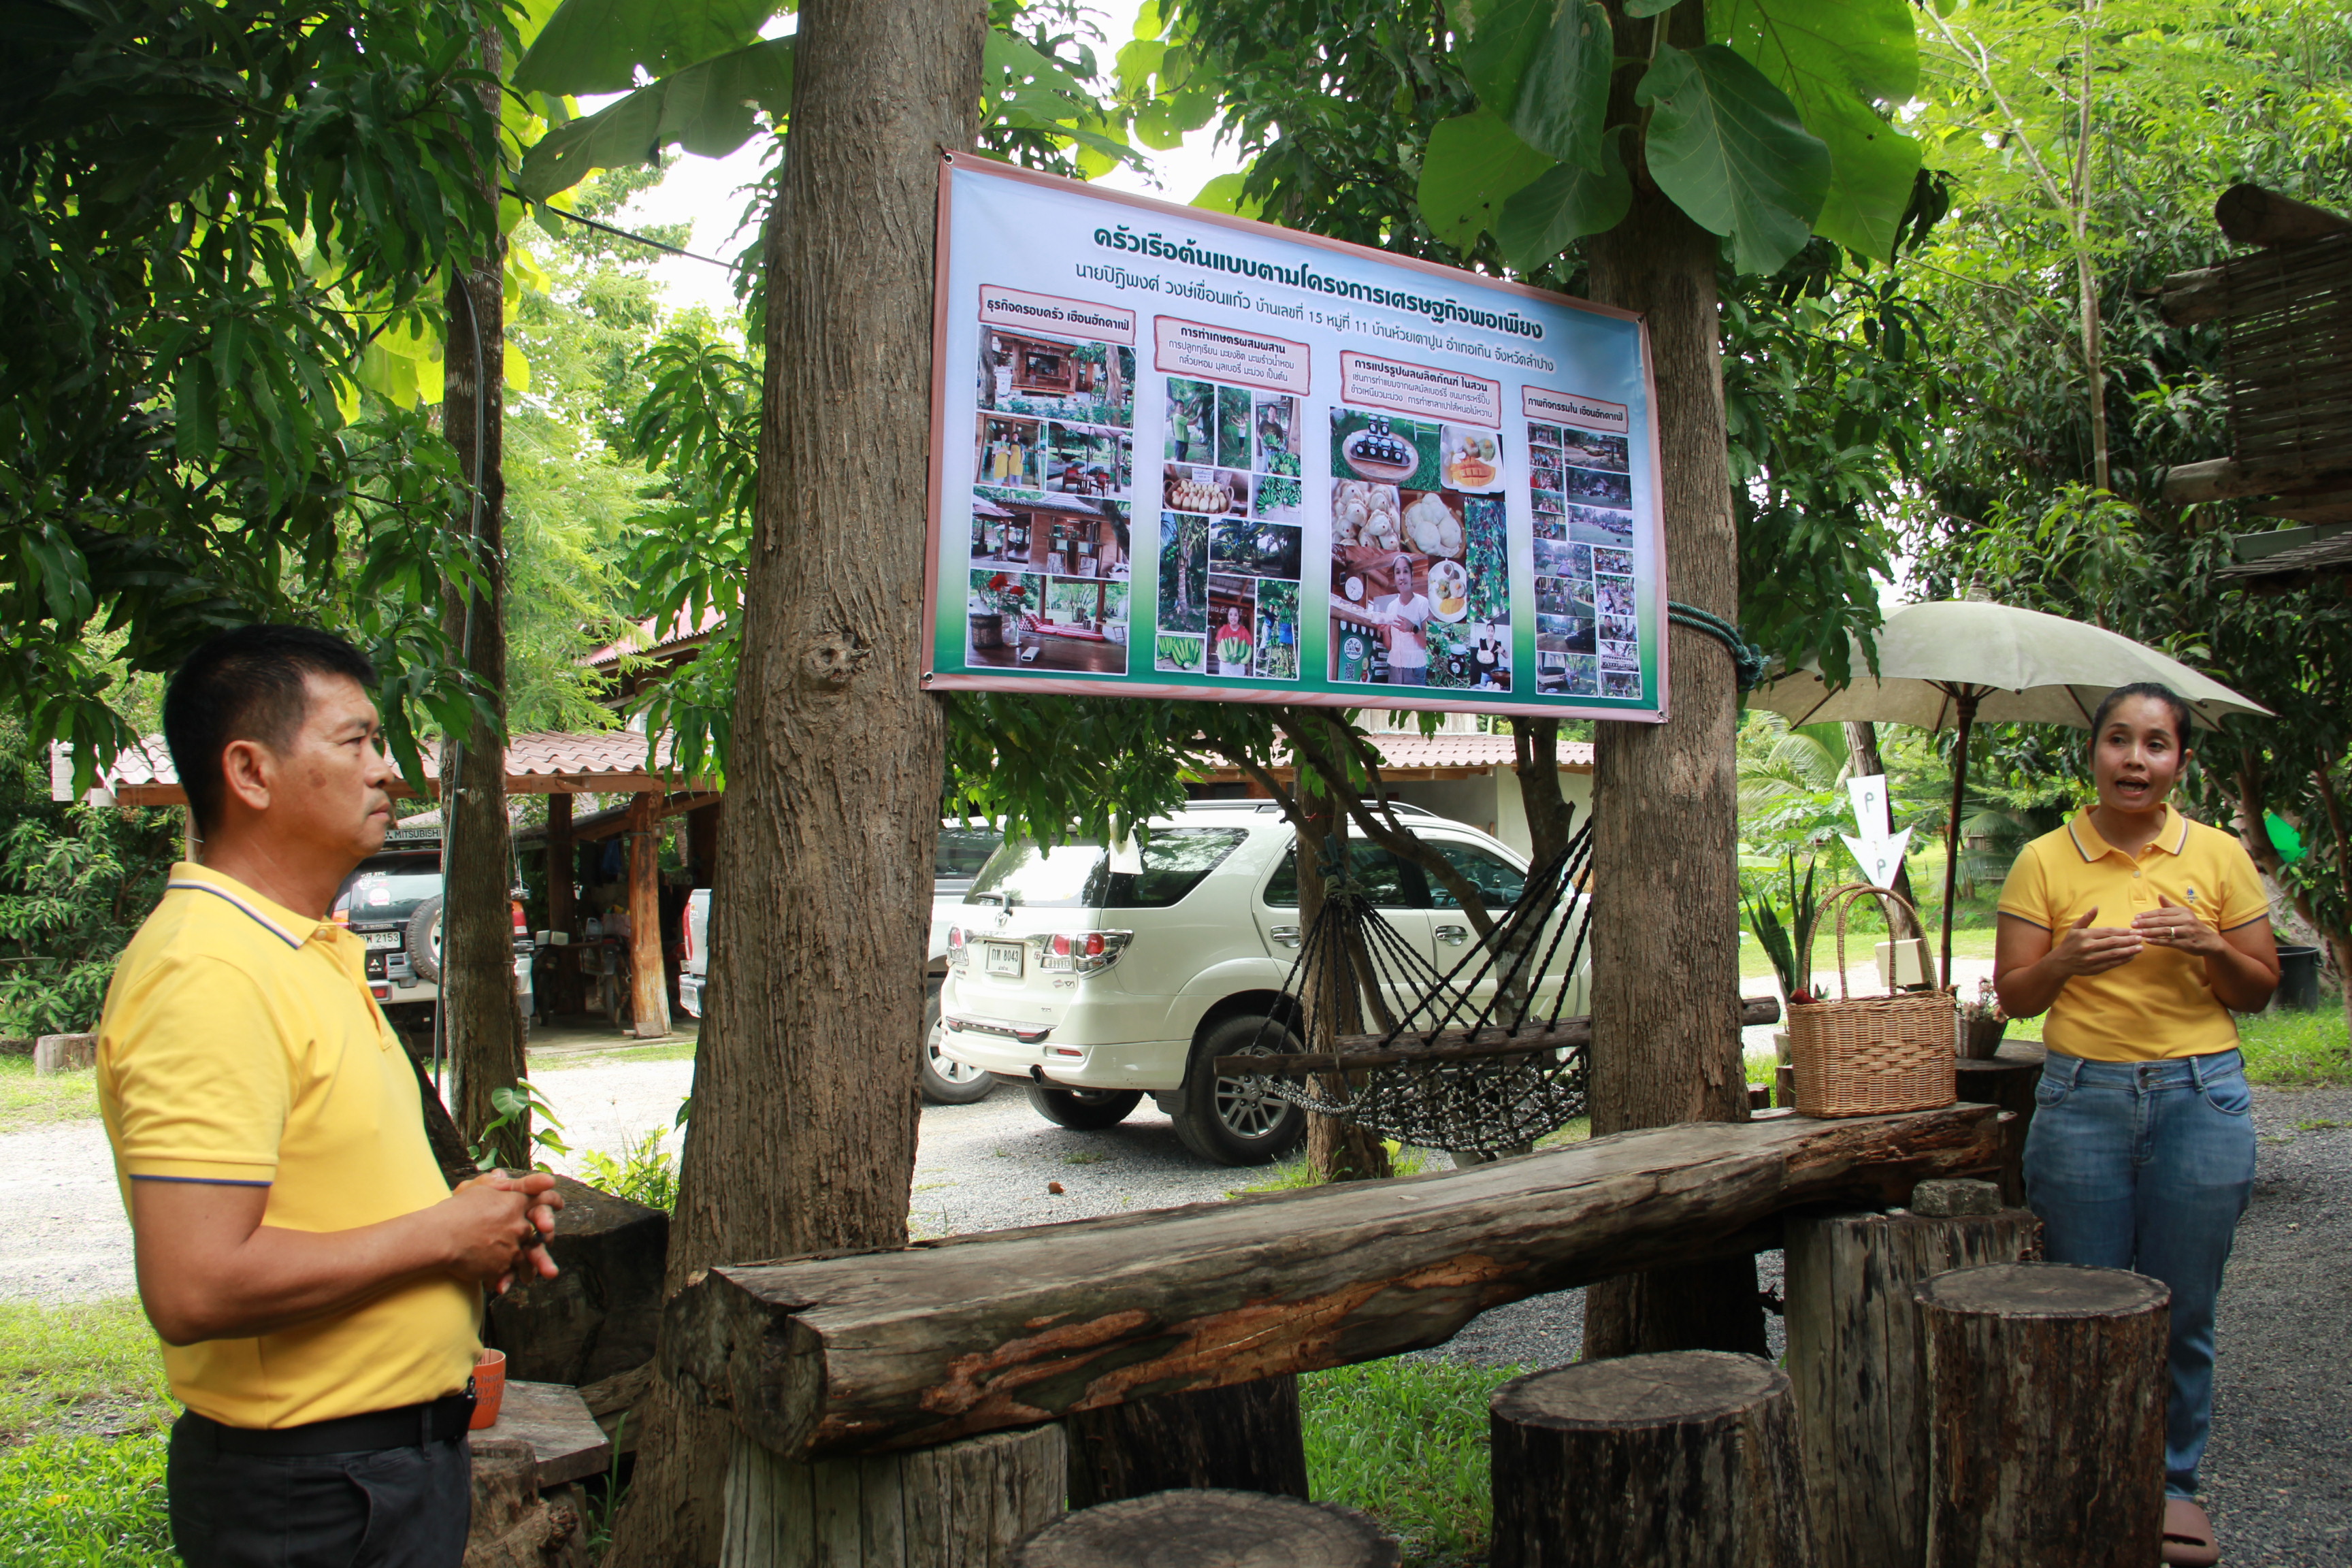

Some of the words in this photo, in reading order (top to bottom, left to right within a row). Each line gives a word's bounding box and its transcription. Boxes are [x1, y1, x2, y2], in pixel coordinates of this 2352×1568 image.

[987, 299, 1064, 320] ธุรกิจครอบครัว
[1075, 263, 1160, 292] นายปิฏิพงศ์
[1164, 279, 1251, 310] วงษ์เขื่อนแก้ว
[1256, 297, 1304, 321] บ้านเลขที่
[1309, 311, 1322, 324] 15
[1326, 312, 1350, 332] หมู่ที่
[1355, 321, 1367, 333] 11
[1371, 321, 1443, 350] บ้านห้วยเตาปูน
[1446, 337, 1492, 359] อำเภอเถิน
[1494, 347, 1554, 372] จังหวัดลำปาง
[1181, 327, 1286, 354] การทำเกษตรผสมผสาน
[1169, 340, 1218, 355] การปลูกทุเรียน
[1220, 349, 1246, 361] มะยงชิด
[1248, 354, 1294, 369] มะพร้าวน้ำหอม
[1179, 354, 1213, 369] กล้วยหอม
[1243, 366, 1264, 377] มะม่วง
[1267, 368, 1288, 381] เป็นต้น
[1354, 359, 1459, 387] การแปรรูปผลผลิตภัณฑ์
[1460, 376, 1488, 392] ในสวน
[1351, 384, 1403, 402] ข้าวเหนียวมะม่วง
[1528, 397, 1578, 414] ภาพกิจกรรมใน
[395, 829, 442, 839] MITSUBISHI
[376, 932, 399, 943] 2153
[1003, 949, 1019, 962] 8043
